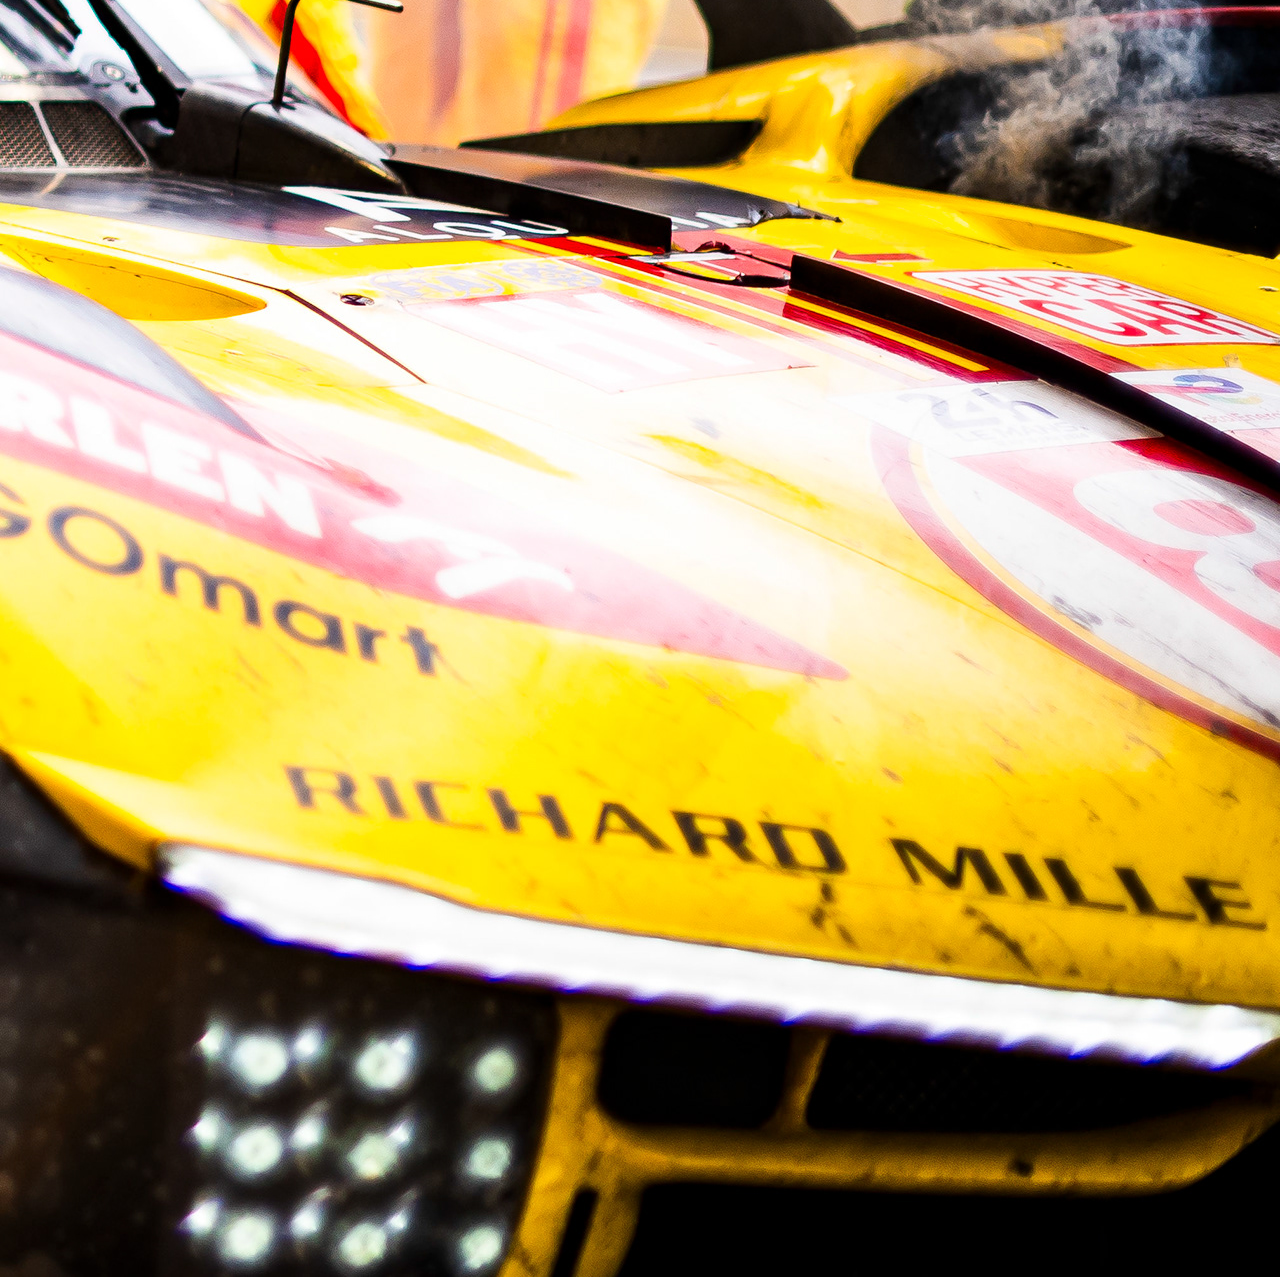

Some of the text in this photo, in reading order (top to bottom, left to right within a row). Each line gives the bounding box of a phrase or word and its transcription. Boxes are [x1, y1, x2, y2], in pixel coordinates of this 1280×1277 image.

[1019, 298, 1246, 338] CAR
[282, 765, 1267, 931] RICHARD MILLE
